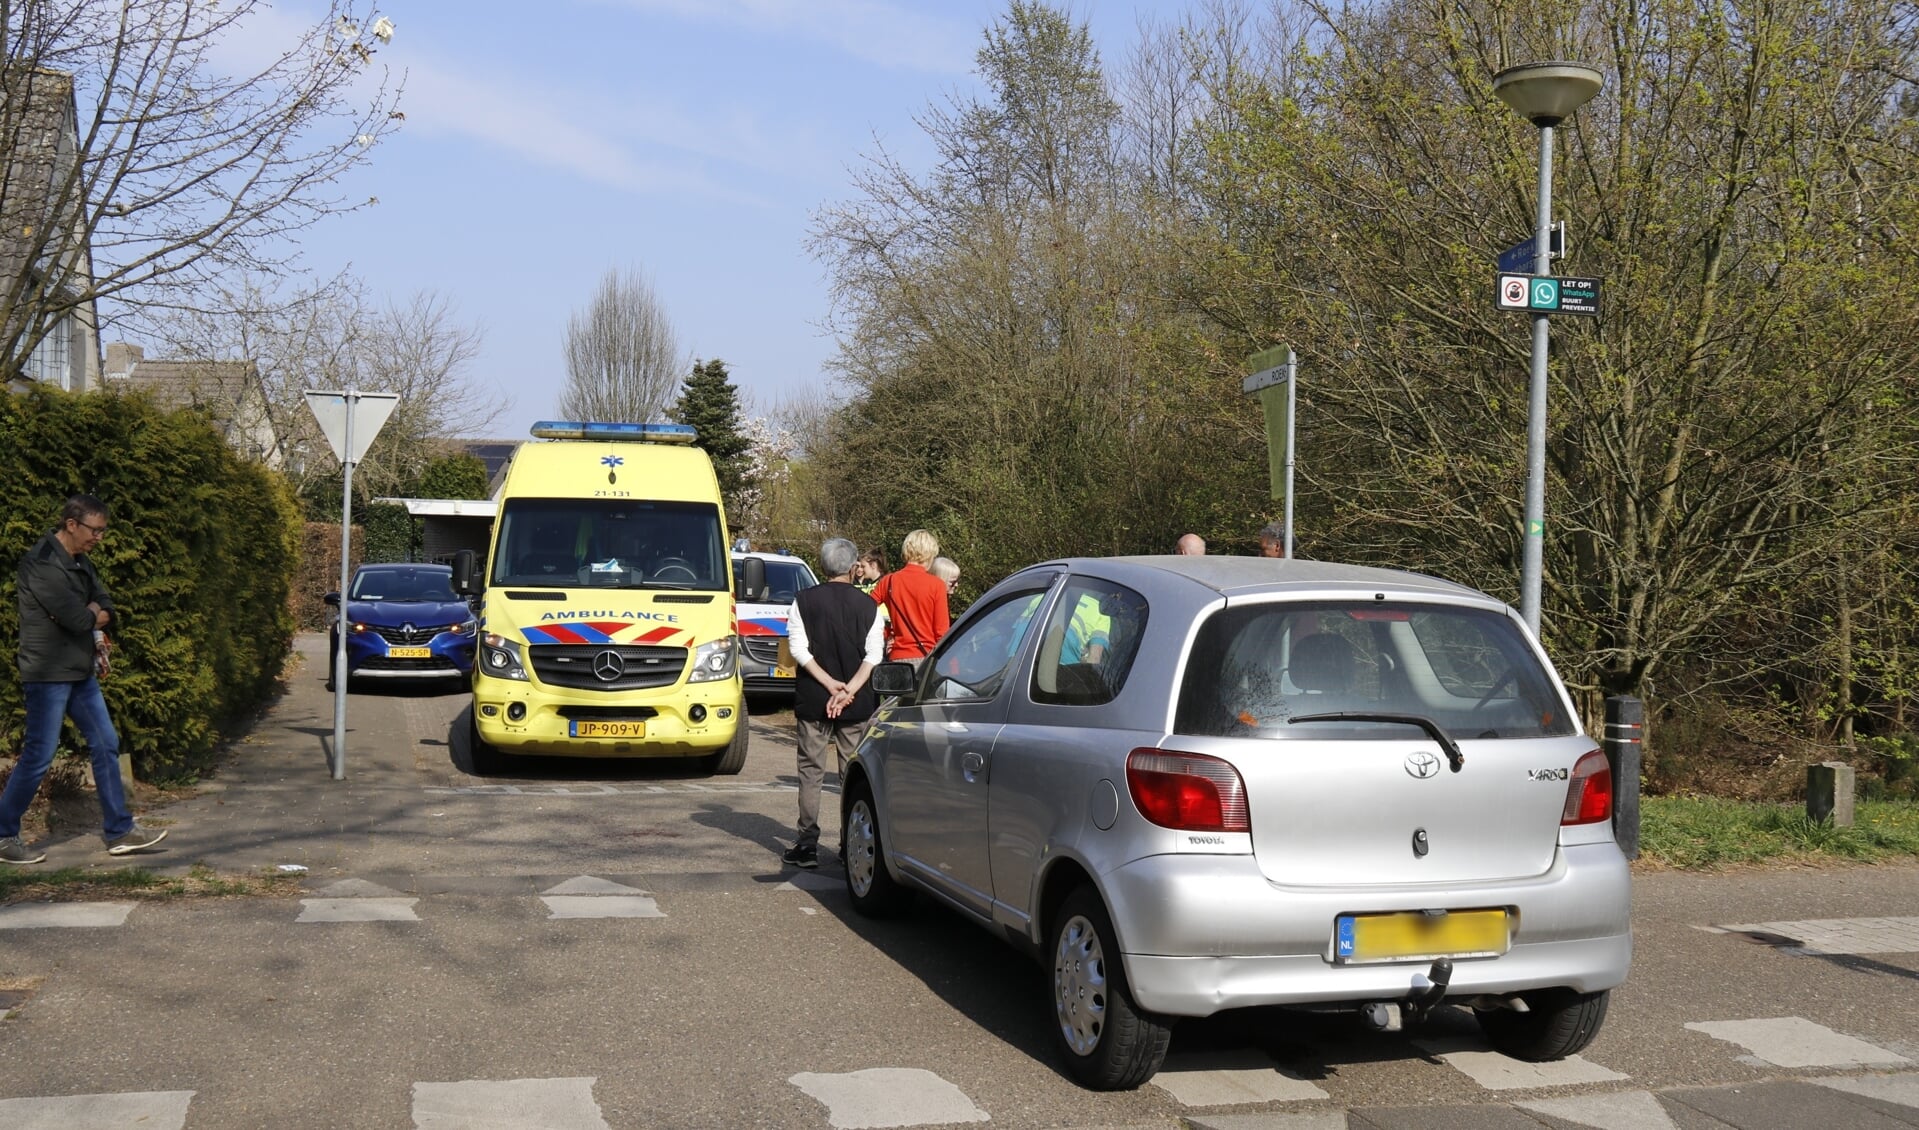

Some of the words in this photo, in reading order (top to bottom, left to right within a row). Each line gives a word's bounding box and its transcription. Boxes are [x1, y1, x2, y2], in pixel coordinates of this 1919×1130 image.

[1562, 280, 1576, 288] LET
[1577, 281, 1592, 289] OP!
[1562, 289, 1595, 298] WhatsApp
[1561, 304, 1595, 312] PREVENTIE
[541, 610, 679, 623] AMBULANCE
[581, 723, 640, 735] JP-909-V
[1340, 940, 1353, 950] NL
